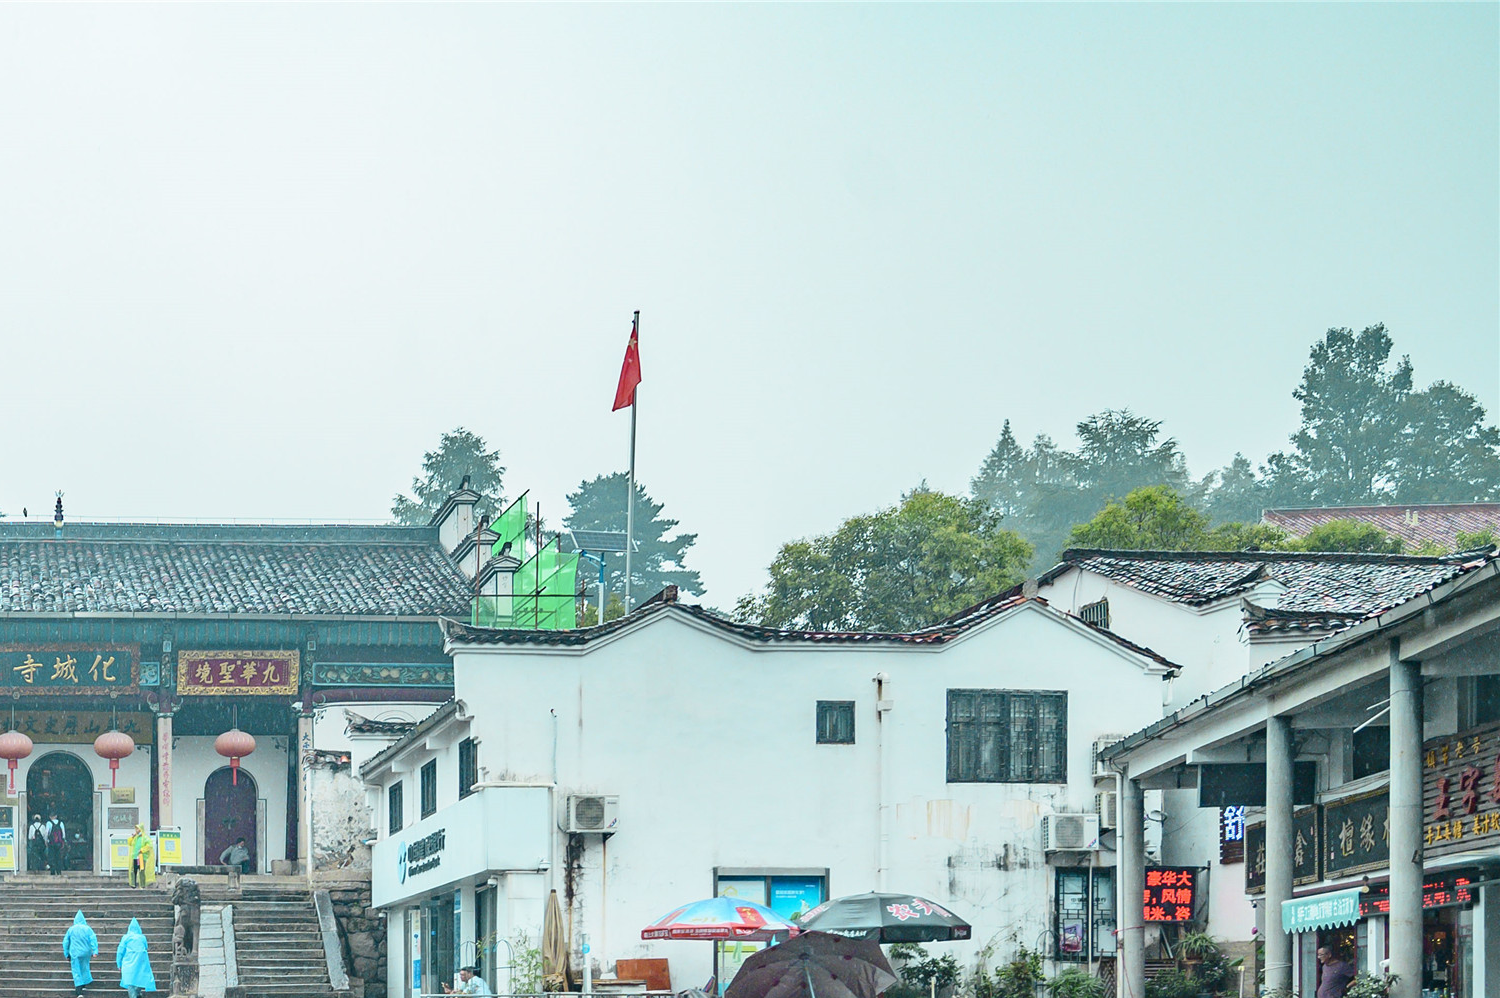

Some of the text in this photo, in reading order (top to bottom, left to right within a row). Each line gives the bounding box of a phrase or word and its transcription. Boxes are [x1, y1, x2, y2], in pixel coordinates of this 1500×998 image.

[12, 653, 117, 684] 化城寺
[1146, 870, 1192, 886] 豪华大
